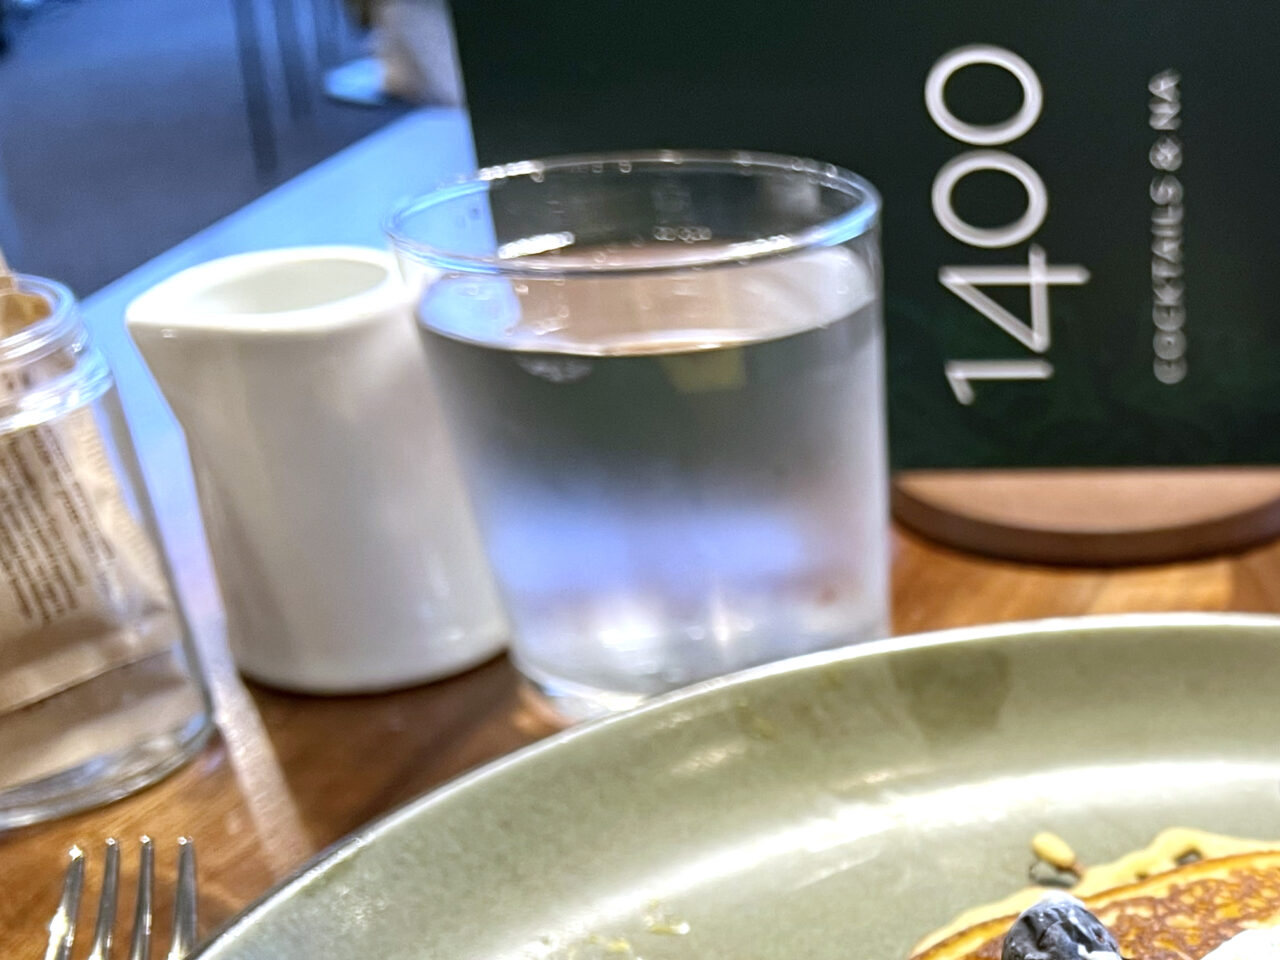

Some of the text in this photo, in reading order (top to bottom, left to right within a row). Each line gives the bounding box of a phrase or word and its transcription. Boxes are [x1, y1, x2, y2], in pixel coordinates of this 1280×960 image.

[924, 44, 1090, 406] 1400
[1147, 67, 1188, 386] COCKTAILS & NA
